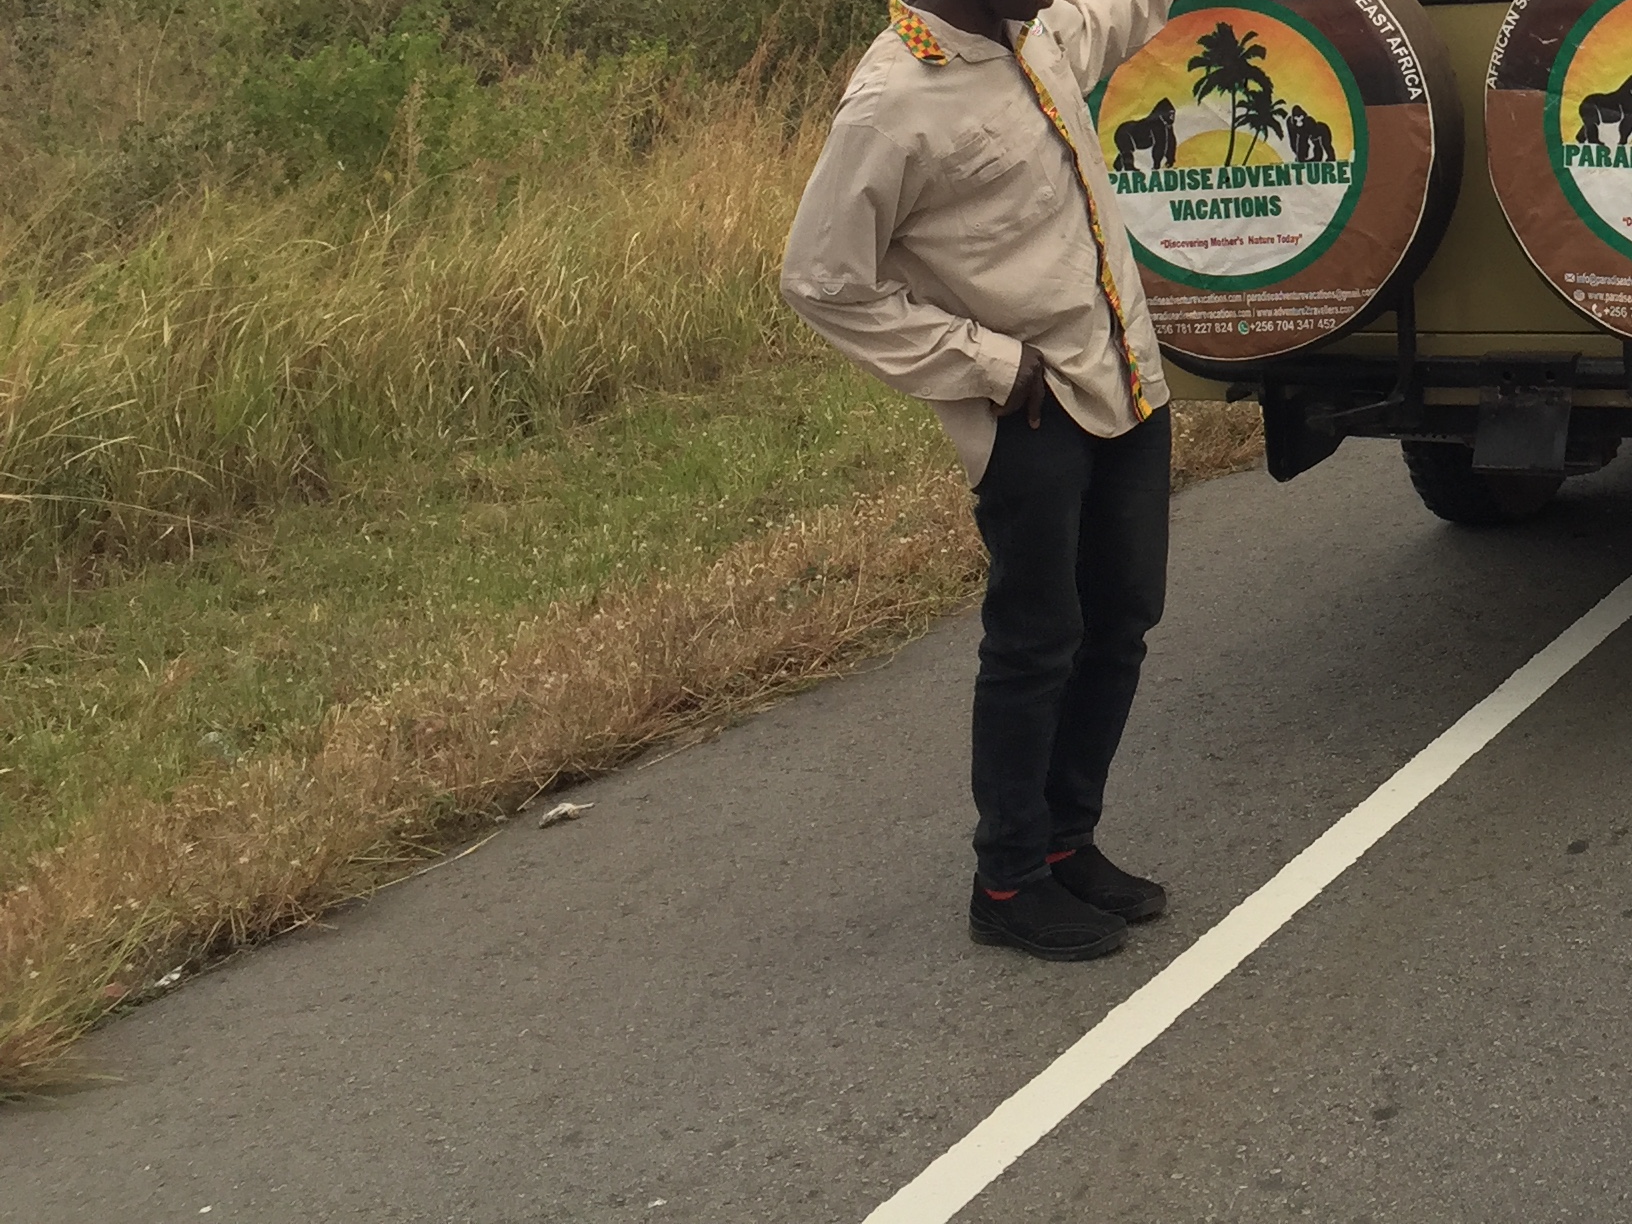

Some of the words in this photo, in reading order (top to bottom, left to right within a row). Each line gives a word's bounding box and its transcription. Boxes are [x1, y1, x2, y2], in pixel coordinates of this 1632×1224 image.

[1486, 12, 1521, 90] AFRICAN
[1386, 34, 1423, 101] AFRICA
[1216, 162, 1351, 189] ADVENTURE
[1169, 195, 1282, 222] VACATIONS
[1248, 233, 1276, 245] Nature
[1603, 306, 1628, 318] +256
[1176, 323, 1192, 335] 781
[1194, 322, 1212, 334] 227
[1214, 321, 1233, 333] 824
[1250, 320, 1275, 333] +256
[1276, 320, 1294, 331] 704
[1297, 319, 1314, 331] 347
[1318, 318, 1337, 329] 452
